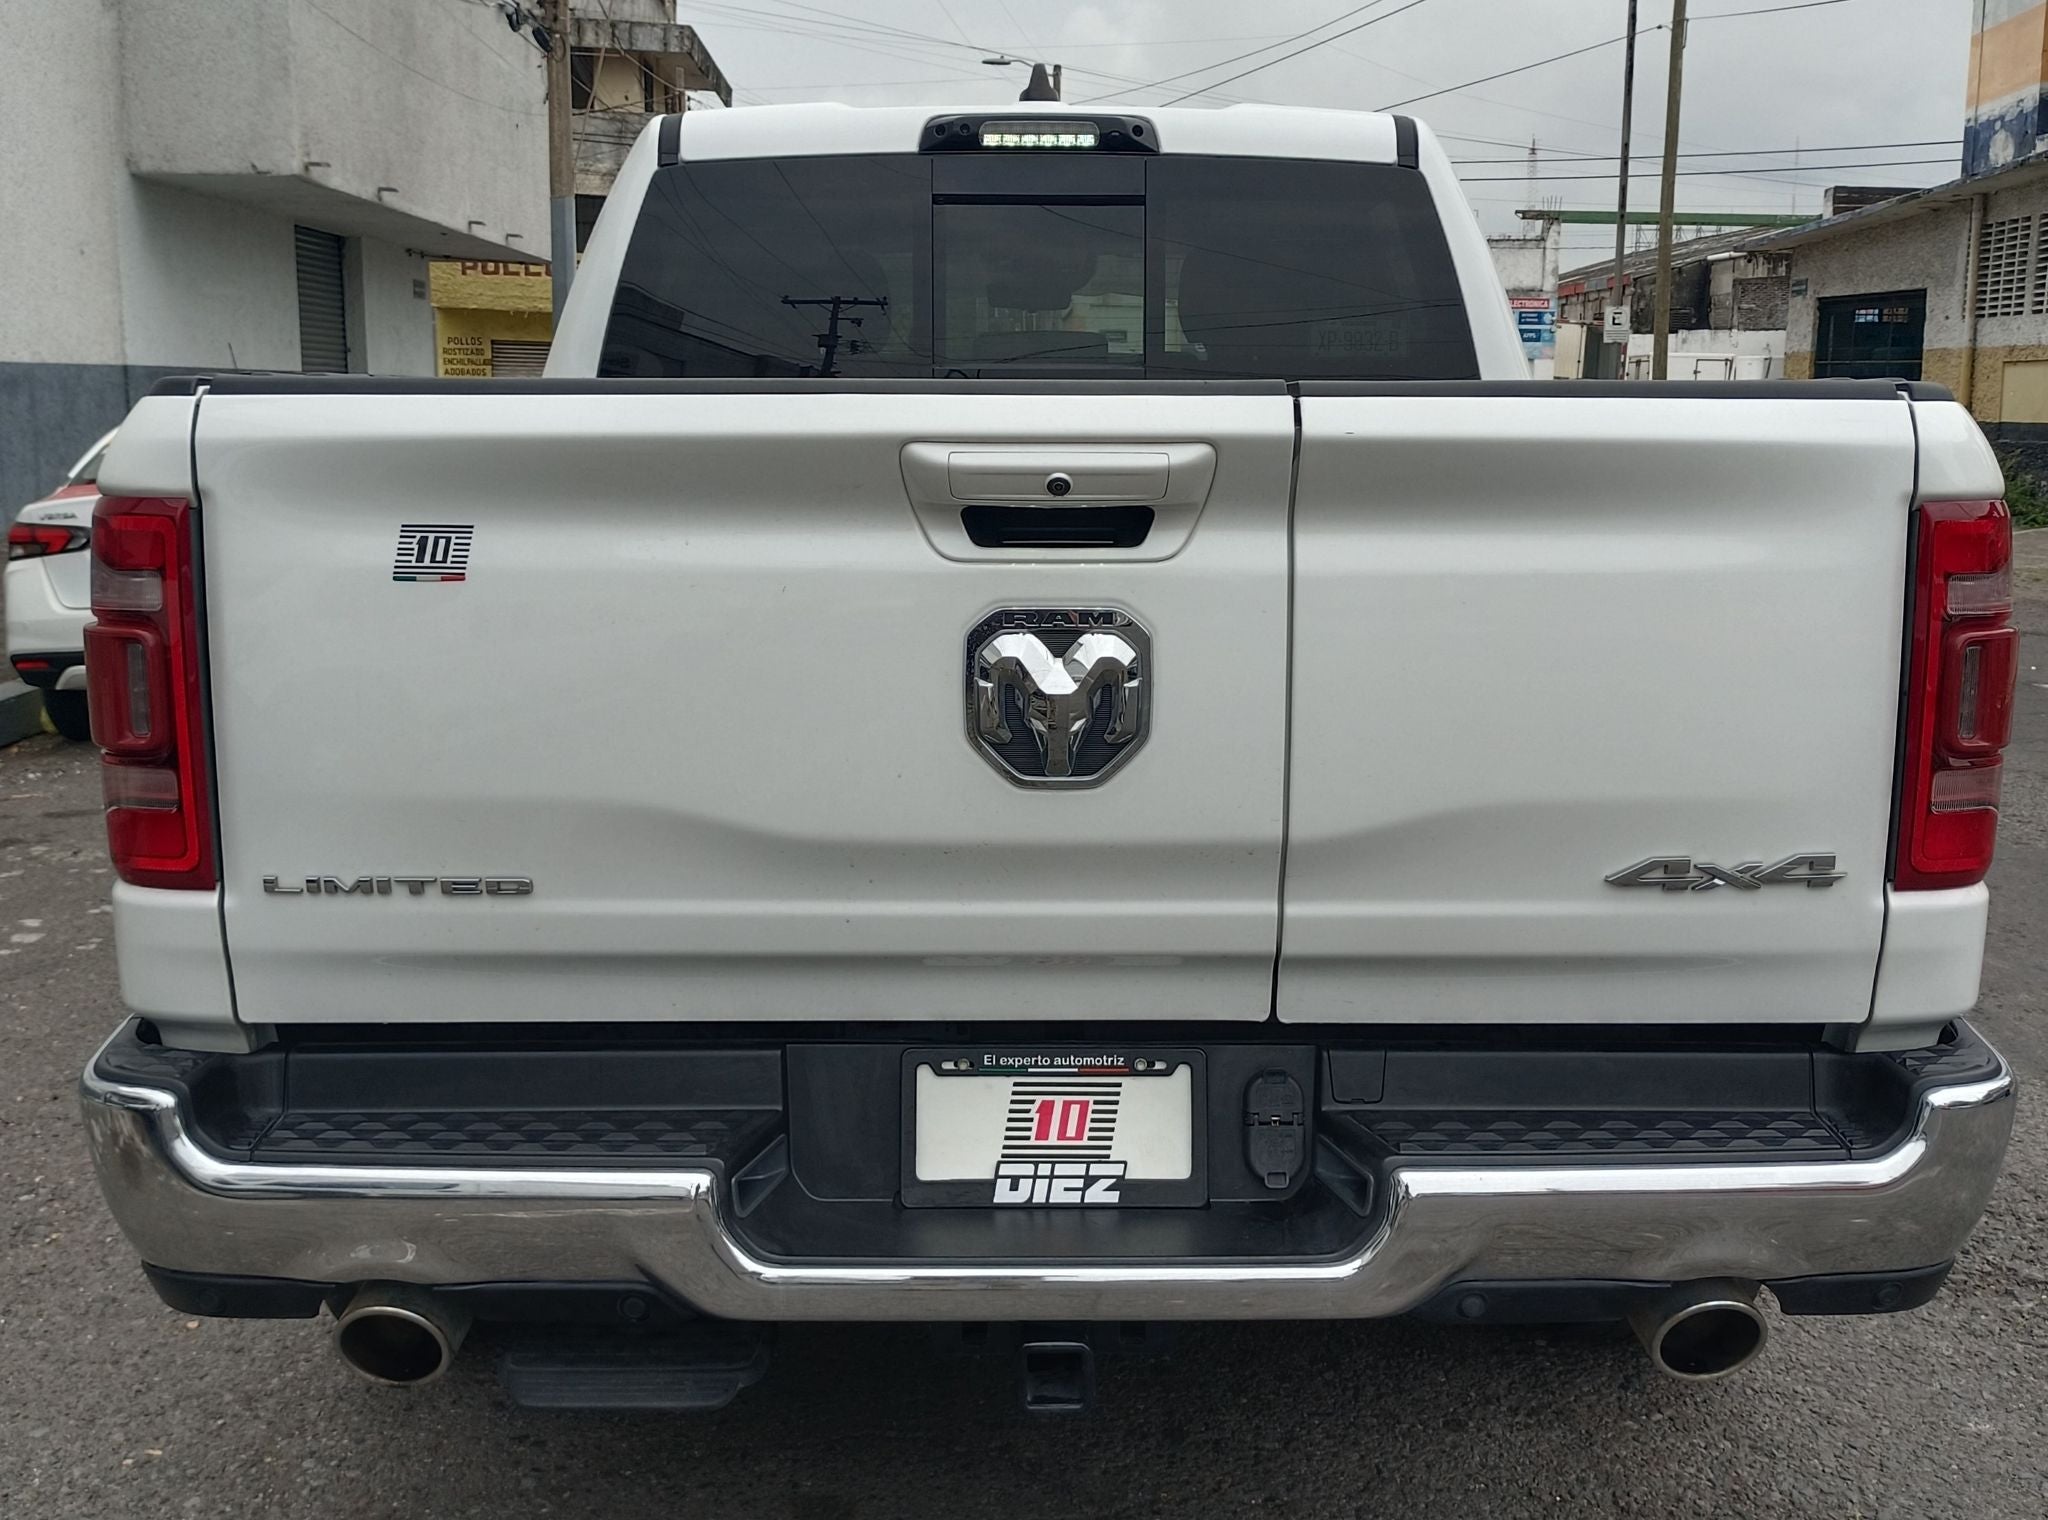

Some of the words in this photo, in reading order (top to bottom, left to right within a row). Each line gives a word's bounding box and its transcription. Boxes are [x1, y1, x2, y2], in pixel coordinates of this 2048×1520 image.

[447, 336, 483, 346] POLLOS
[444, 367, 487, 377] ADOBADOS
[415, 535, 453, 564] 10
[1002, 610, 1114, 627] RAM
[262, 875, 534, 896] LIMITED
[983, 1053, 996, 1066] El
[999, 1054, 1051, 1068] experto
[1053, 1054, 1125, 1066] automotriz
[1034, 1099, 1091, 1141] 10
[993, 1162, 1126, 1204] DIEZ
